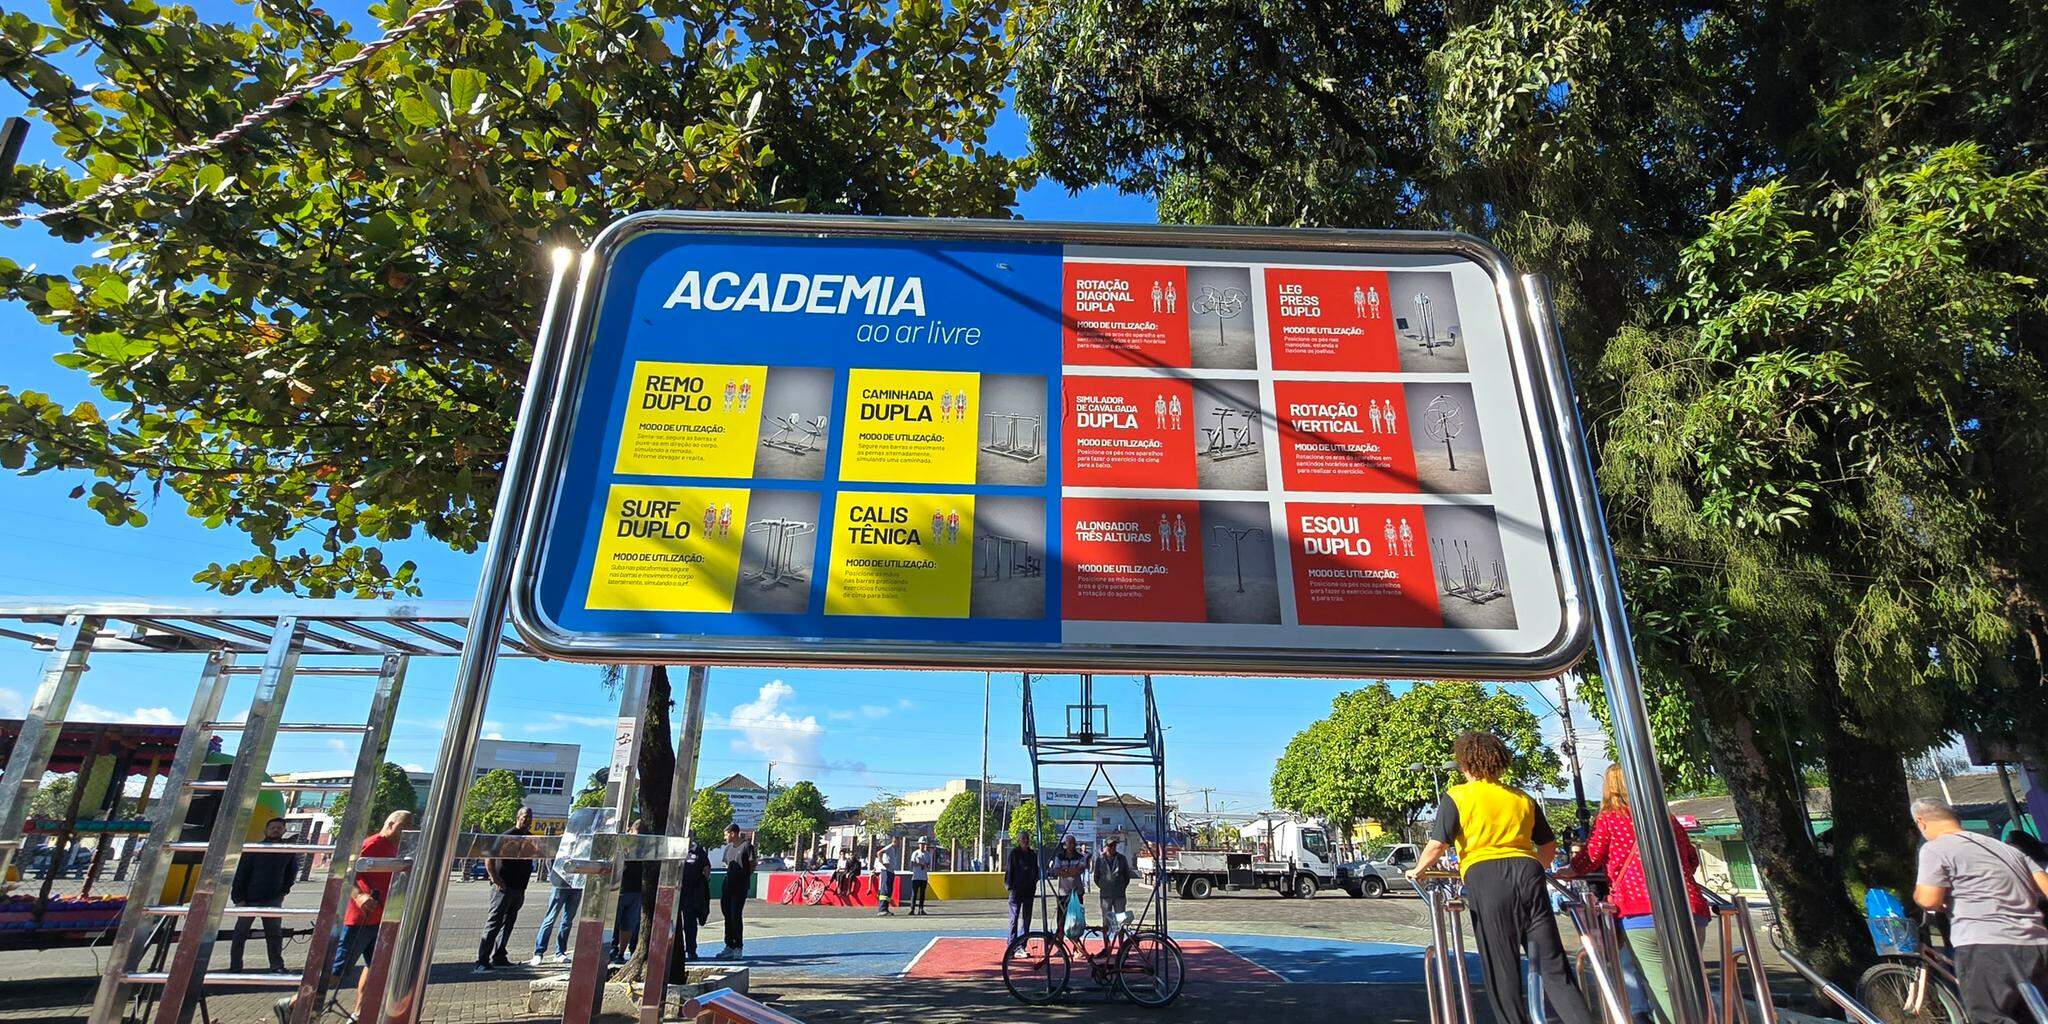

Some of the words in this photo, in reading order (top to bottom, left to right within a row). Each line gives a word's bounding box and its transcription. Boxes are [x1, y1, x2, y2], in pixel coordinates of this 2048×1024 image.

[1076, 279, 1129, 292] ROTAÇÃO
[1279, 284, 1303, 295] LEG
[662, 270, 926, 317] ACADEMIA
[1076, 291, 1135, 302] DIAGONAL
[1280, 295, 1319, 306] PRESS
[1077, 302, 1115, 313] DUPLA
[1281, 306, 1321, 317] DUPLO
[1077, 321, 1099, 329] MODO
[1111, 321, 1158, 331] UTILIZAÇÃO:
[1283, 326, 1305, 334] MODO
[1317, 326, 1365, 336] UTILIZAÇÃO:
[856, 323, 889, 344] ao
[894, 325, 925, 345] ar
[928, 320, 981, 346] livre
[646, 375, 704, 393] REMO
[863, 389, 934, 401] CAMINHADA
[1076, 396, 1124, 404] SIMULADOR
[642, 393, 712, 412] DUPLO
[861, 404, 933, 422] DUPLA
[1077, 404, 1087, 412] DE
[1088, 405, 1138, 413] CAVALGADA
[1290, 402, 1359, 419] ROTAÇÃO
[1077, 413, 1139, 429] DUPLA
[1291, 420, 1364, 433] VERTICAL
[639, 423, 662, 431] MODO
[676, 424, 726, 434] UTILIZAÇÃO:
[859, 433, 882, 441] MODO
[895, 433, 944, 443] UTILIZAÇÃO:
[1077, 439, 1100, 447] MODO
[1101, 439, 1112, 447] DE
[1113, 439, 1163, 449] UTILIZAÇÃO:
[1318, 444, 1329, 452] DE
[1331, 443, 1380, 453] UTILIZAÇÃO:
[621, 500, 681, 518] SURF
[850, 506, 908, 523] CALIS
[617, 520, 691, 539] DUPLO
[1075, 521, 1139, 531] ALONGADOR
[1301, 516, 1360, 536] ESQUI
[848, 524, 921, 545] TÊNICA
[1075, 530, 1103, 542] TRÊS
[1104, 533, 1152, 543] ALTURAS
[1303, 537, 1372, 556] DUPLO
[613, 553, 638, 561] MODO
[640, 554, 651, 562] DE
[652, 554, 705, 564] UTILIZAÇÃO:
[846, 559, 870, 567] MODO
[871, 560, 883, 568] DE
[884, 560, 937, 569] UTILIZAÇÃO:
[1078, 564, 1102, 573] MODO
[1103, 565, 1115, 573] DE
[1116, 564, 1169, 575] UTILIZAÇÃO:
[1308, 569, 1332, 578] MODO
[1333, 570, 1346, 578] DE
[1346, 569, 1399, 580] UTILIZAÇÃO:
